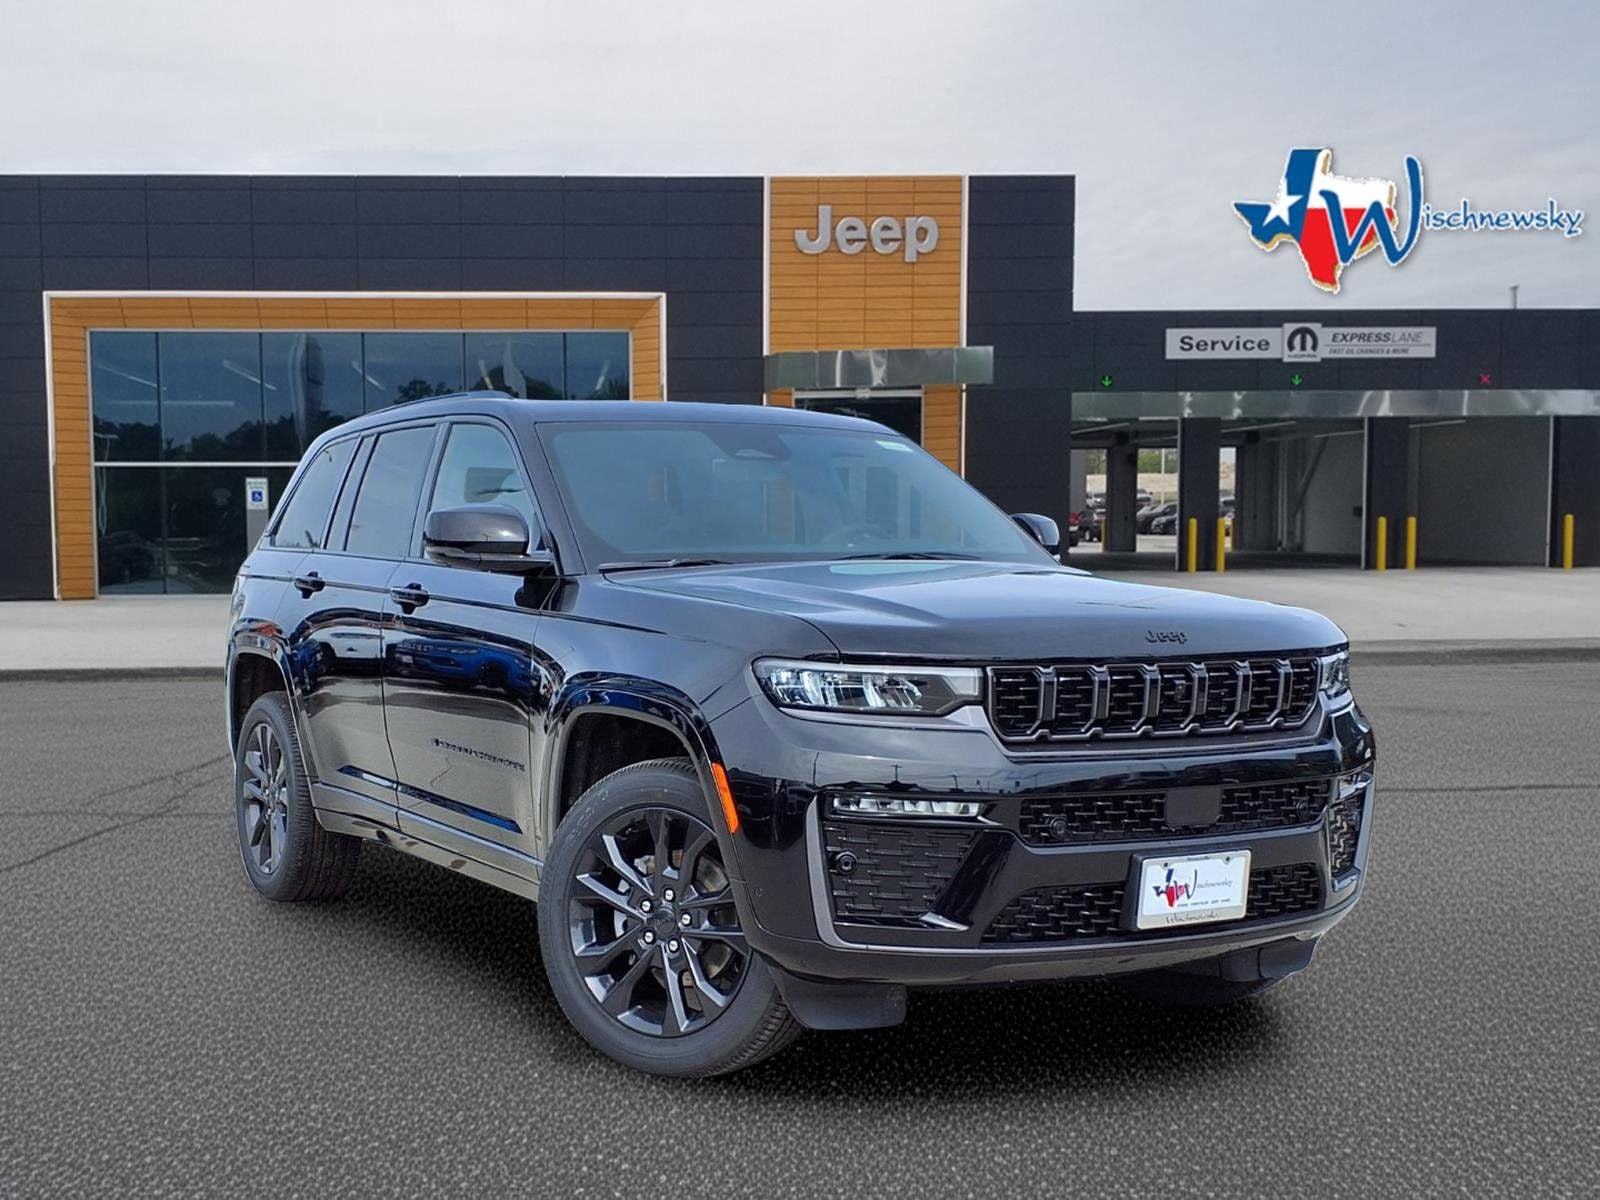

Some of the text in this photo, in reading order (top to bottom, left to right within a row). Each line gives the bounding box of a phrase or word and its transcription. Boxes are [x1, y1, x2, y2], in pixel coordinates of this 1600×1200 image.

[794, 205, 939, 262] Jeep
[1179, 335, 1270, 351] Service
[1145, 630, 1188, 644] Jeep
